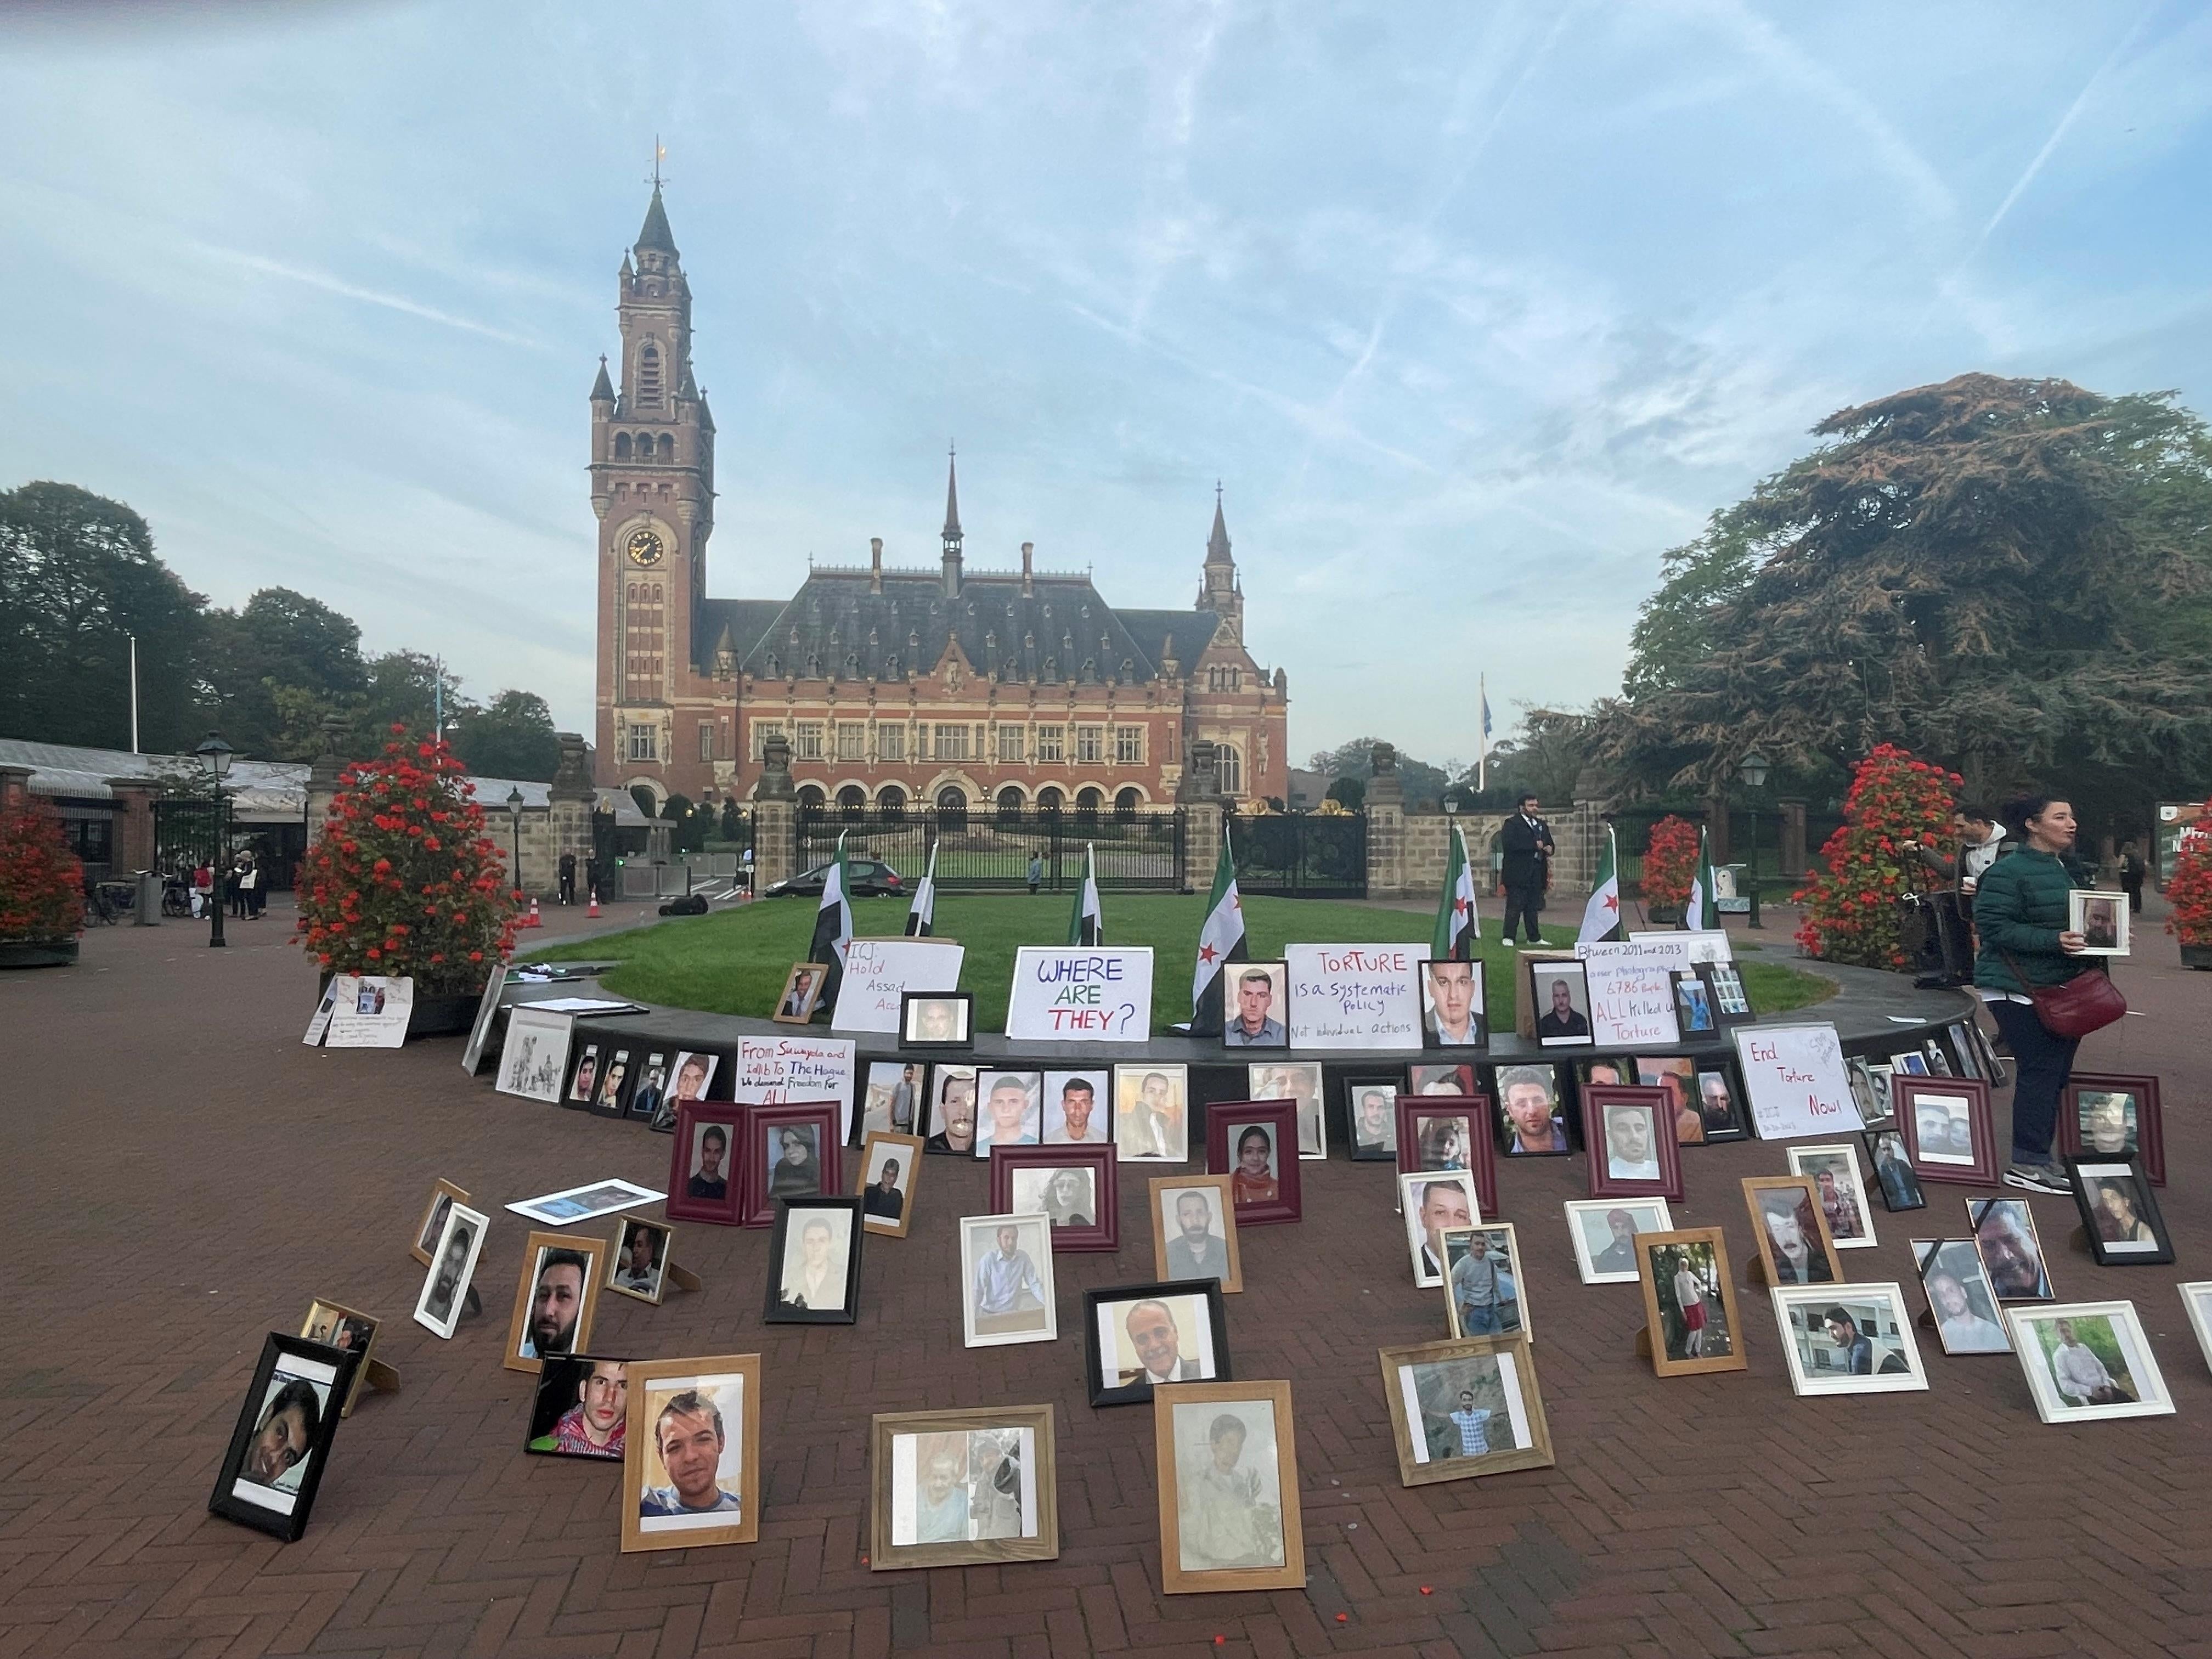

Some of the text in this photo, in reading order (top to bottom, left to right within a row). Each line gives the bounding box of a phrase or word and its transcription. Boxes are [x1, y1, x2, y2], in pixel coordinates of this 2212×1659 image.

[1658, 944, 1682, 955] 2013
[850, 960, 885, 974] Hold
[1038, 957, 1122, 983] WHERE
[866, 979, 905, 992] Assad
[1054, 985, 1101, 1005] ARE
[1611, 1023, 1661, 1040] Torture
[742, 1041, 774, 1059] From
[1750, 1042, 1778, 1062] End
[791, 1061, 811, 1074] The
[814, 1064, 846, 1080] Hague
